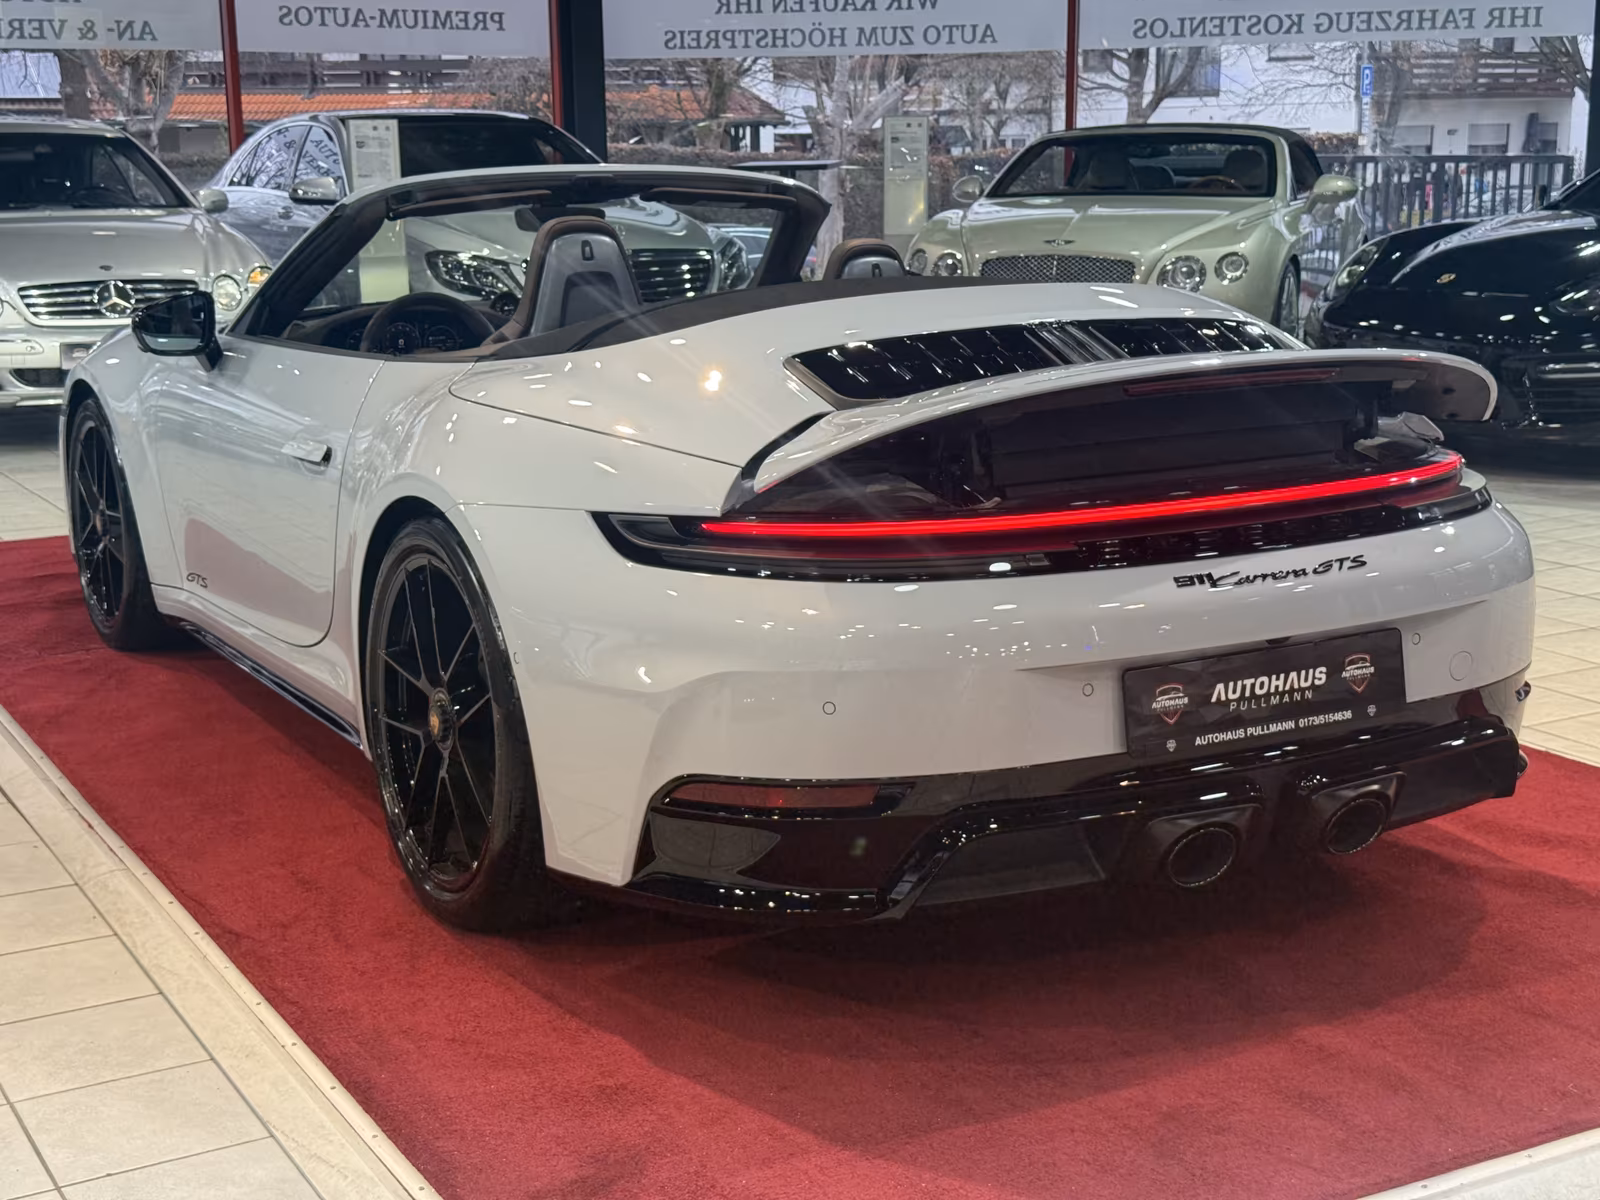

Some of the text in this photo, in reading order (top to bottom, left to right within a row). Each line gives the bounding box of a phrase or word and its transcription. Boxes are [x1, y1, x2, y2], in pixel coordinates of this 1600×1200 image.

[186, 572, 208, 589] GTS
[1173, 554, 1368, 588] 911 Carrera GTS
[1341, 666, 1375, 679] AUTOHAUS
[1211, 666, 1327, 703] AUTOHAUS
[1151, 697, 1189, 709] AUTOHAUS
[1229, 689, 1313, 712] PULLMANN
[1195, 710, 1352, 746] AUTOHAUS PULLMANN 0173/5154636
